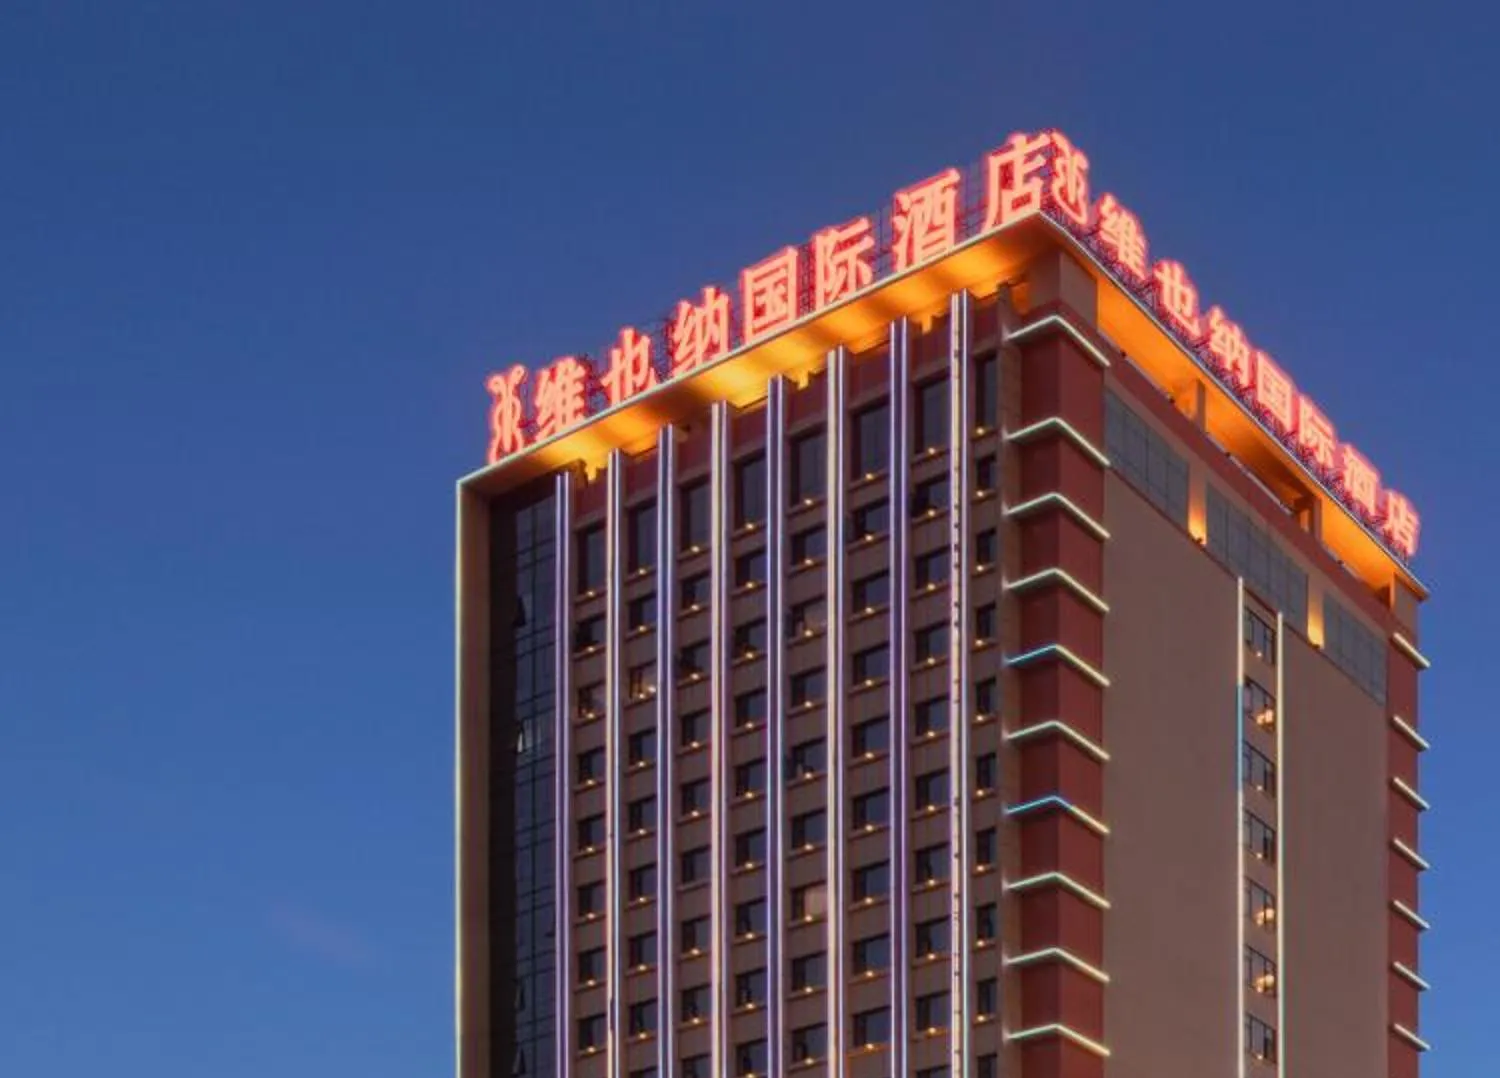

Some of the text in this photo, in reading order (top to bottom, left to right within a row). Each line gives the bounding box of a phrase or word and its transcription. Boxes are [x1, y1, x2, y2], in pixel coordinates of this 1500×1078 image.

[533, 132, 1050, 445] 维也纳国际酒店
[1095, 192, 1420, 556] 维也纳国际酒店
